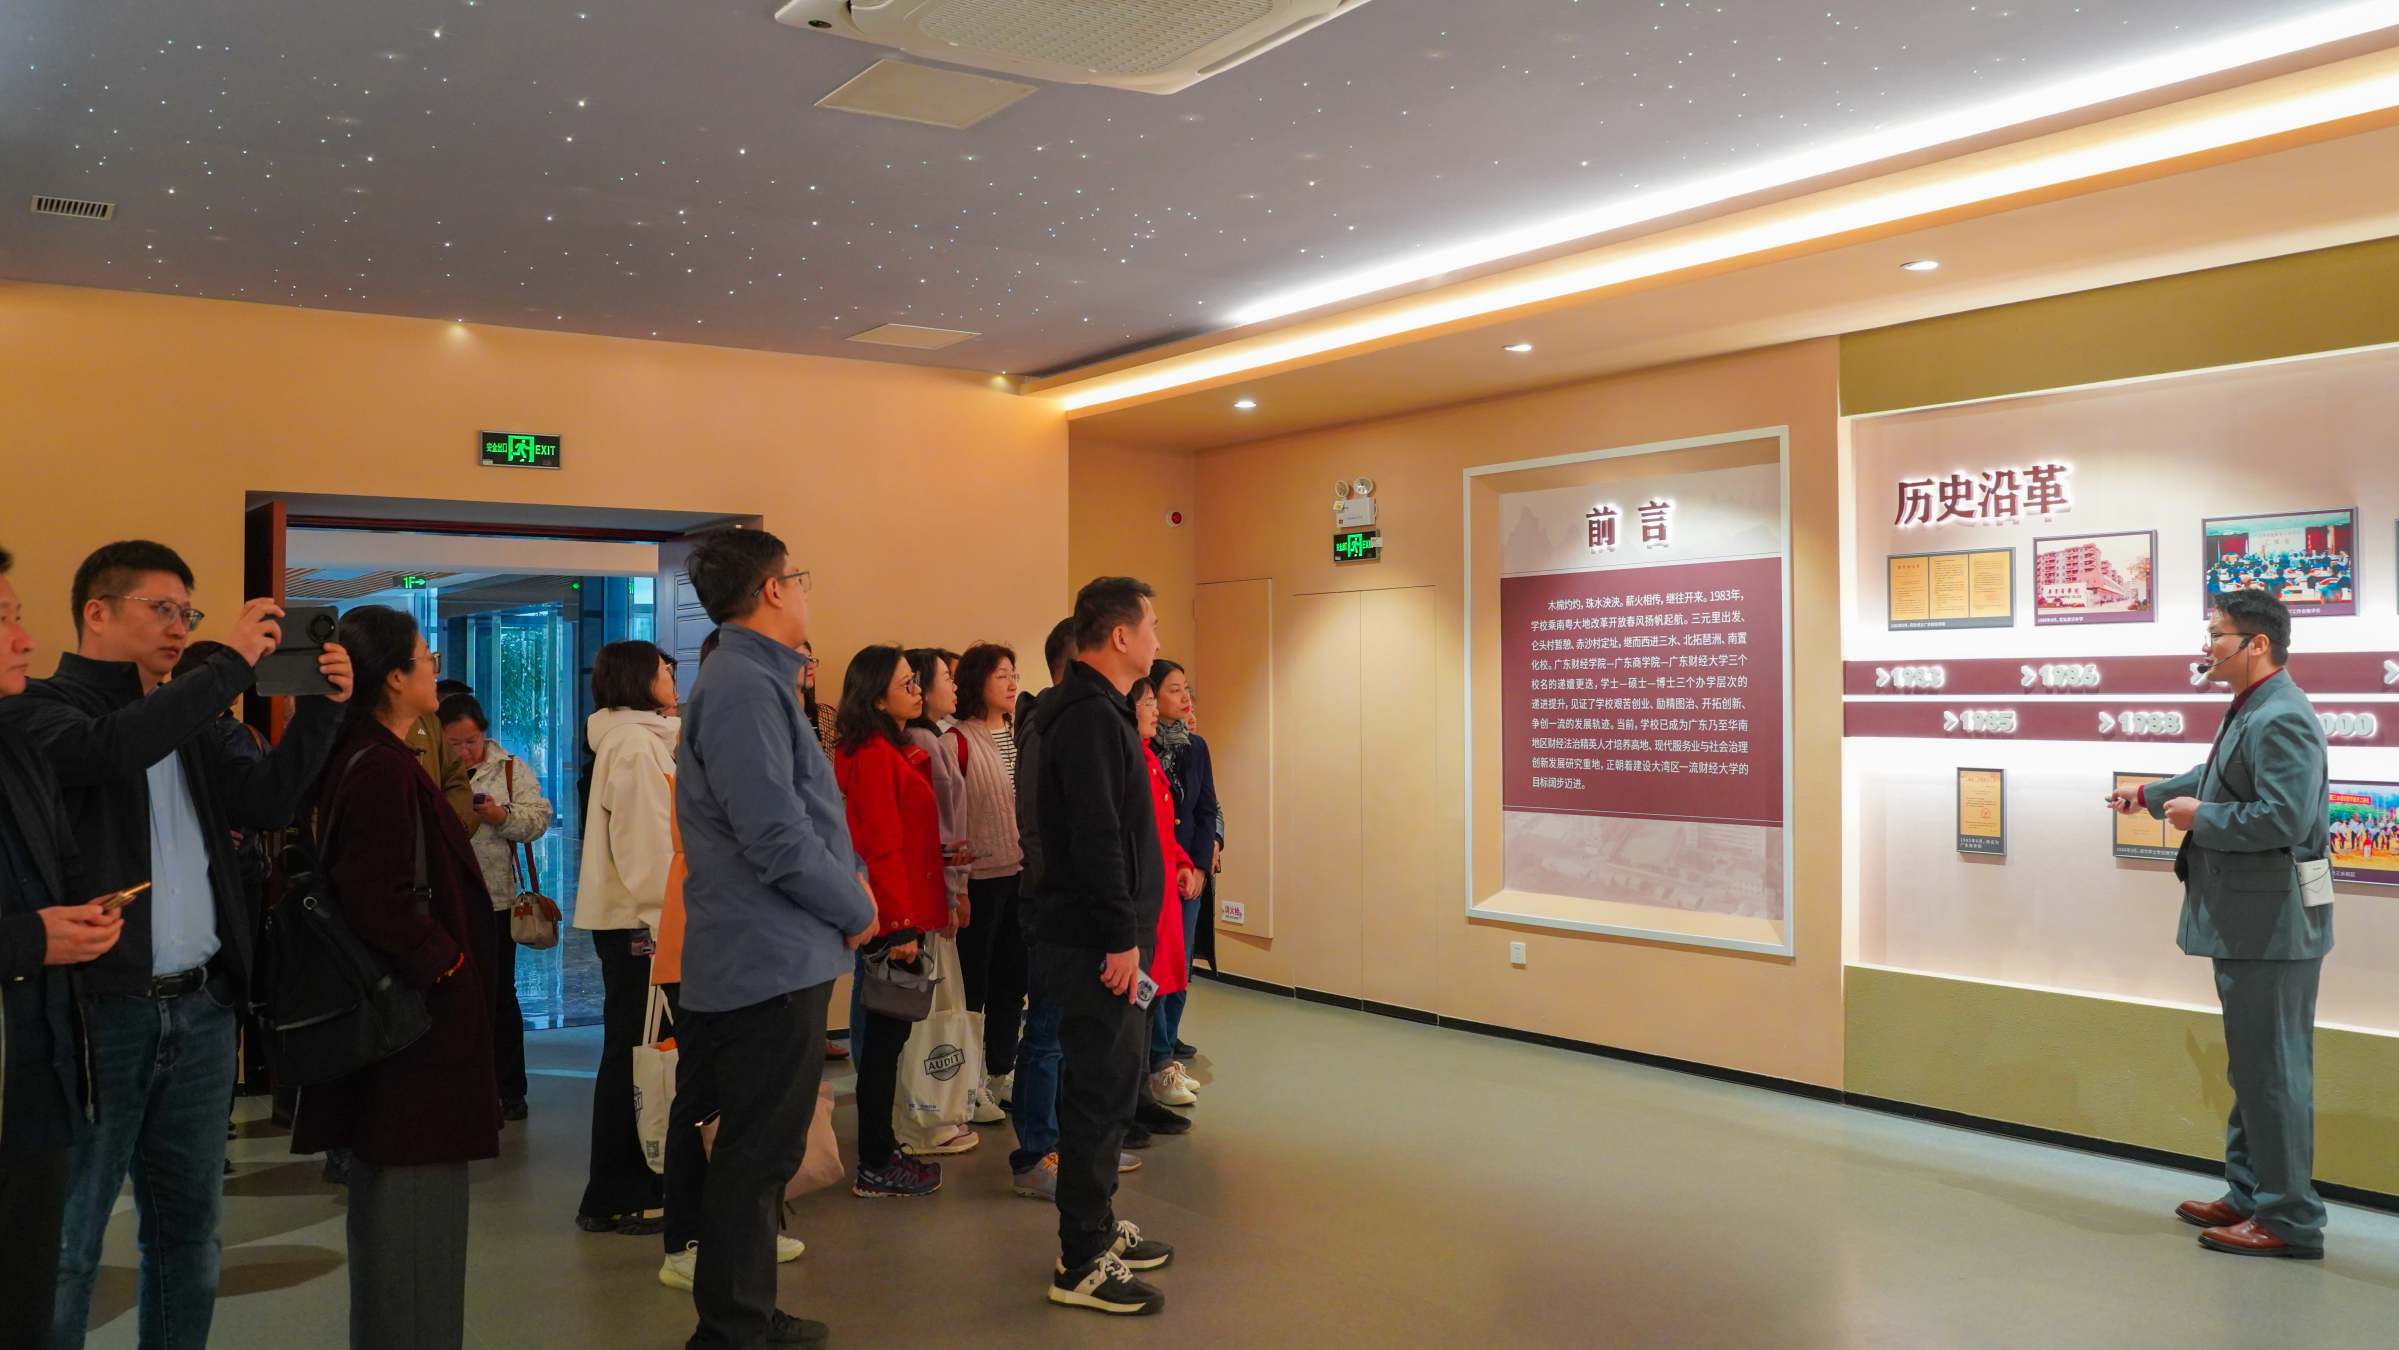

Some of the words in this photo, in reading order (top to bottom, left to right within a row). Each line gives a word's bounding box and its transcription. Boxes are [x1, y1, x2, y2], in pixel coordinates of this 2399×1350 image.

[535, 445, 556, 456] EXIT
[1894, 464, 2069, 526] 历史沿革
[403, 576, 416, 589] 1F
[1891, 666, 1945, 688] 1983
[2038, 664, 2100, 688] 1986
[1959, 710, 2016, 733] 1985
[2118, 711, 2182, 735] 1988
[2319, 712, 2376, 736] 000
[1532, 776, 1586, 790] 目标阔步迈进。
[928, 1054, 960, 1071] AUDIT
